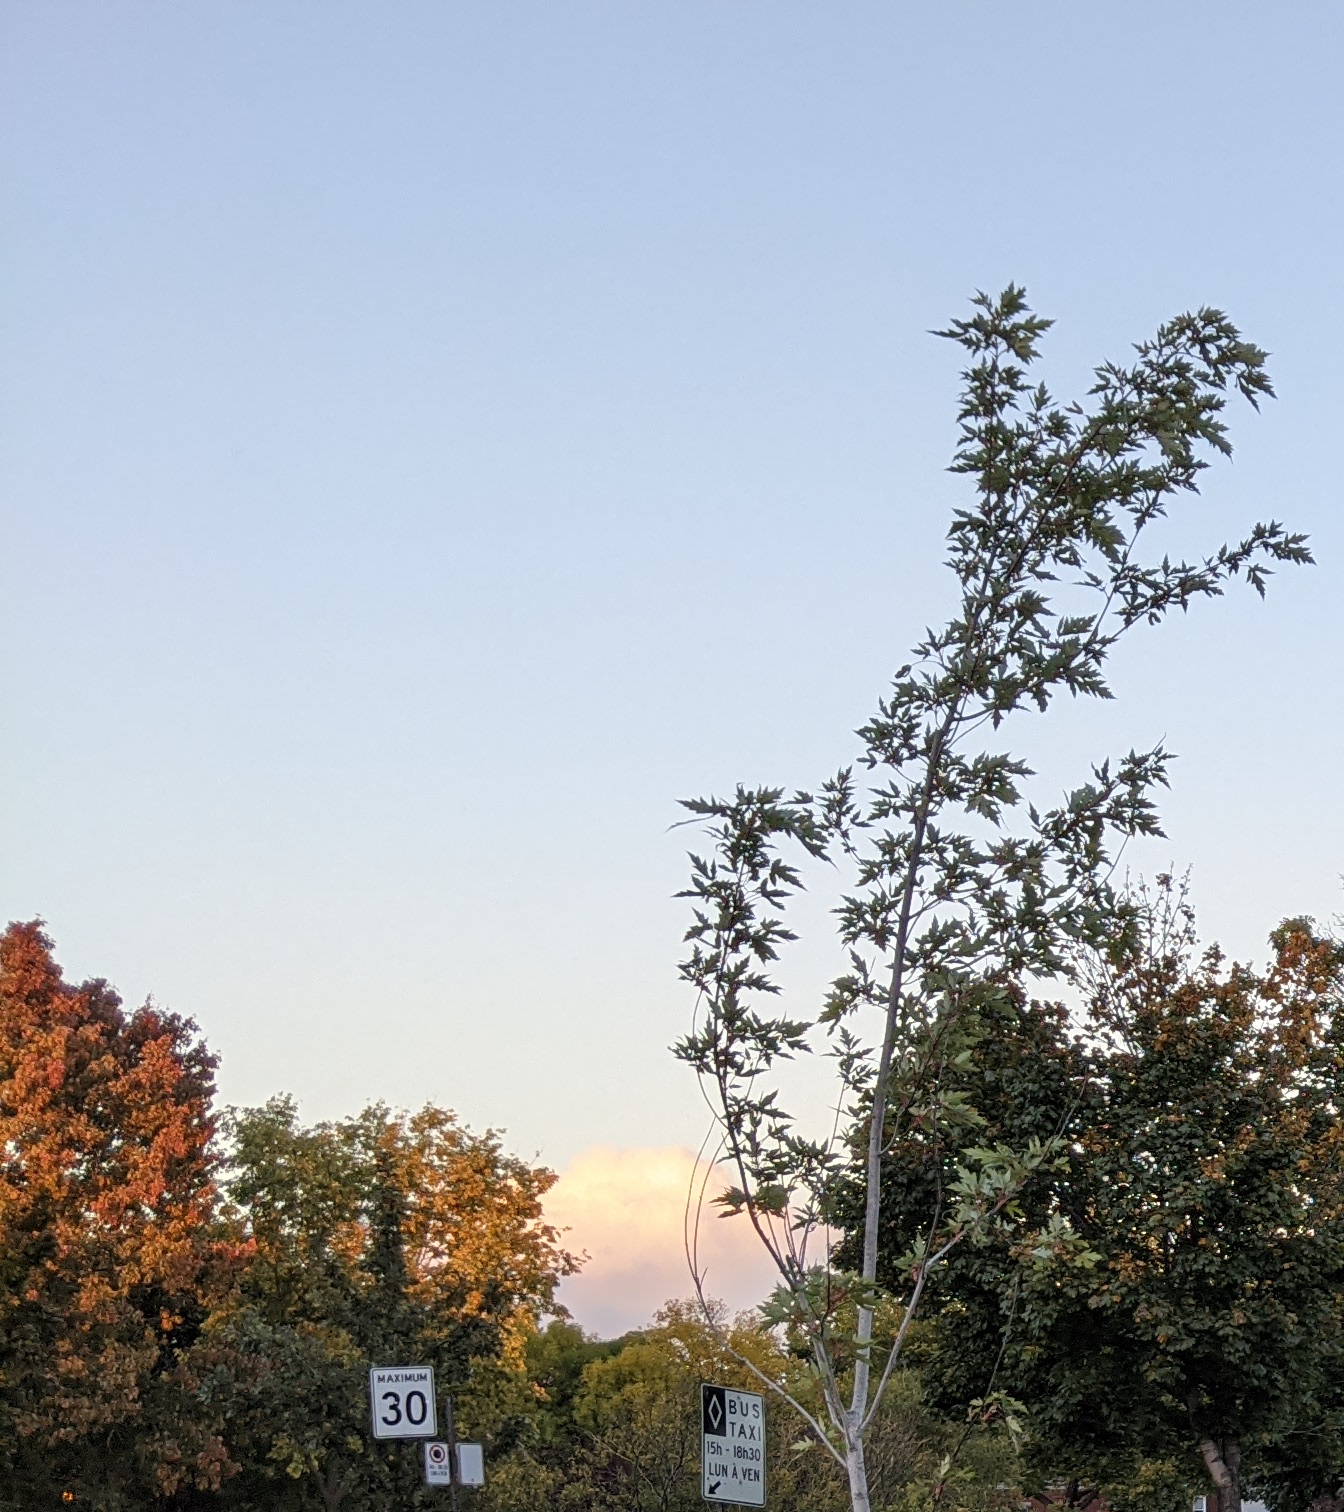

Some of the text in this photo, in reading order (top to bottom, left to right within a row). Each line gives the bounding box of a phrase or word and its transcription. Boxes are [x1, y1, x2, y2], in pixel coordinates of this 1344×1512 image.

[377, 1373, 428, 1383] MAXIMUM
[381, 1391, 428, 1426] 30
[729, 1399, 760, 1419] BUS
[729, 1421, 761, 1441] TAXI
[706, 1441, 722, 1456] 15h
[733, 1444, 761, 1462] 18h30
[708, 1462, 760, 1482] LUN À VEN
